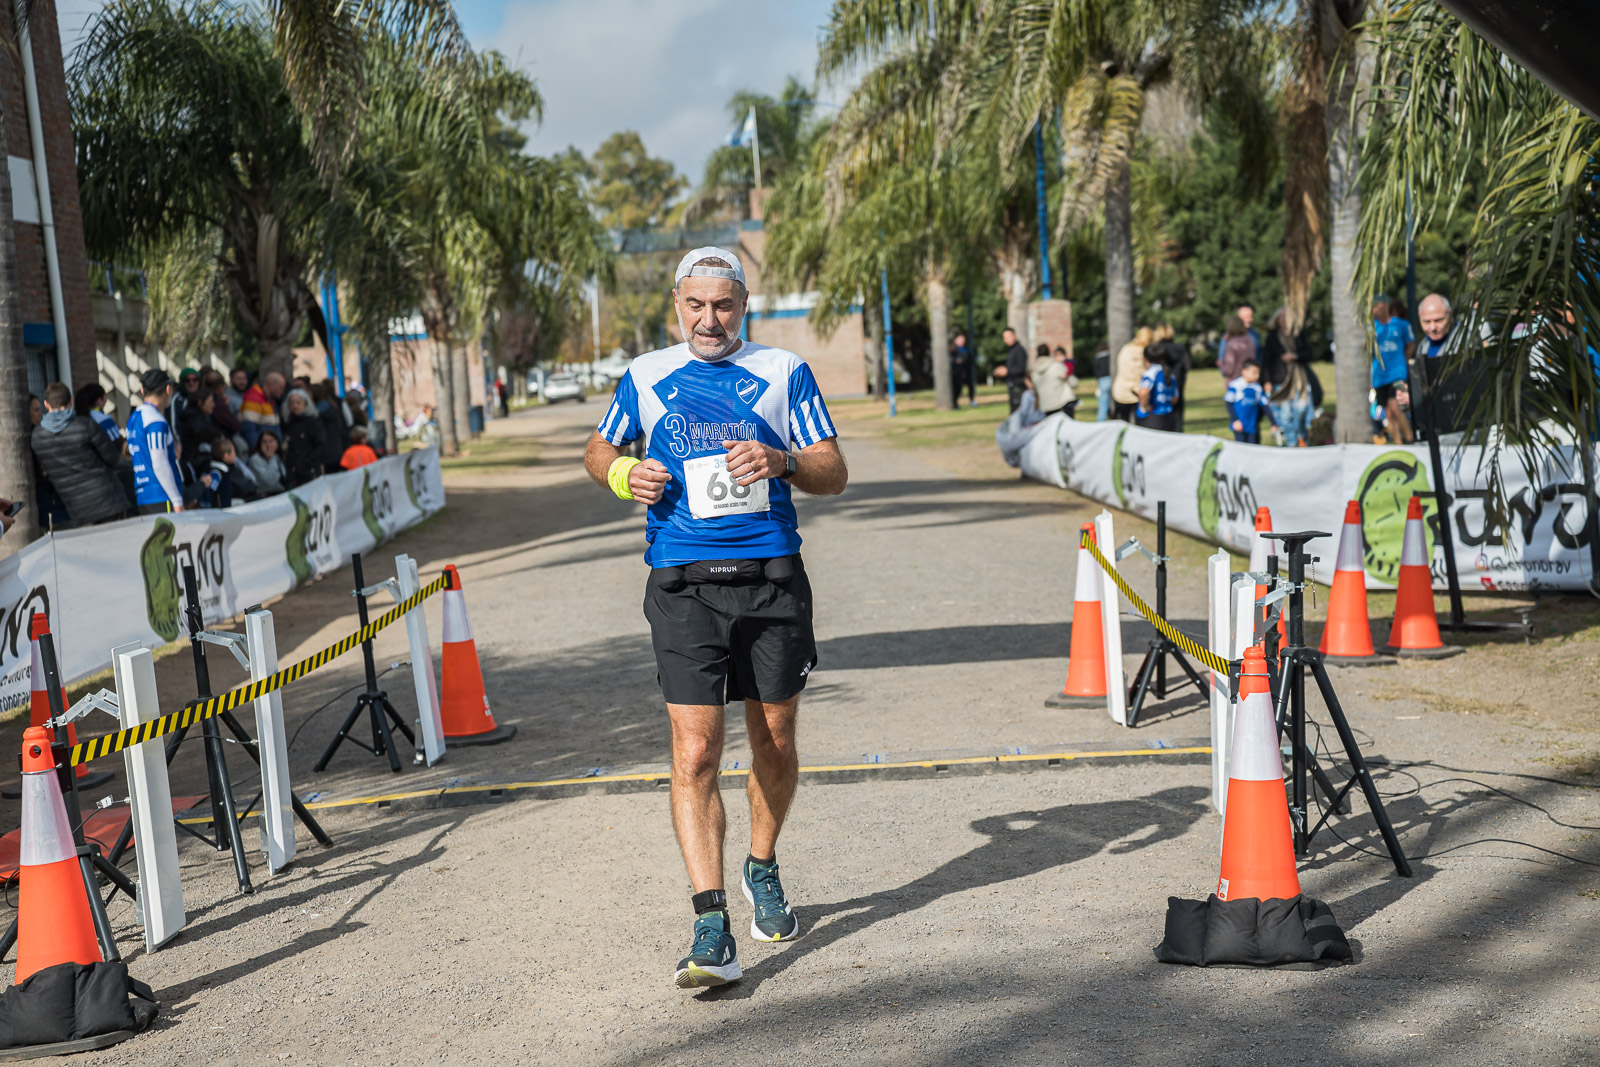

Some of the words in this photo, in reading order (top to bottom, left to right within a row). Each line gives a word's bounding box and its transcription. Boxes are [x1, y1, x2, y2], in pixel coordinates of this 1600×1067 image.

[665, 413, 691, 458] 3
[689, 420, 757, 440] MARATÓN
[706, 472, 751, 501] 68
